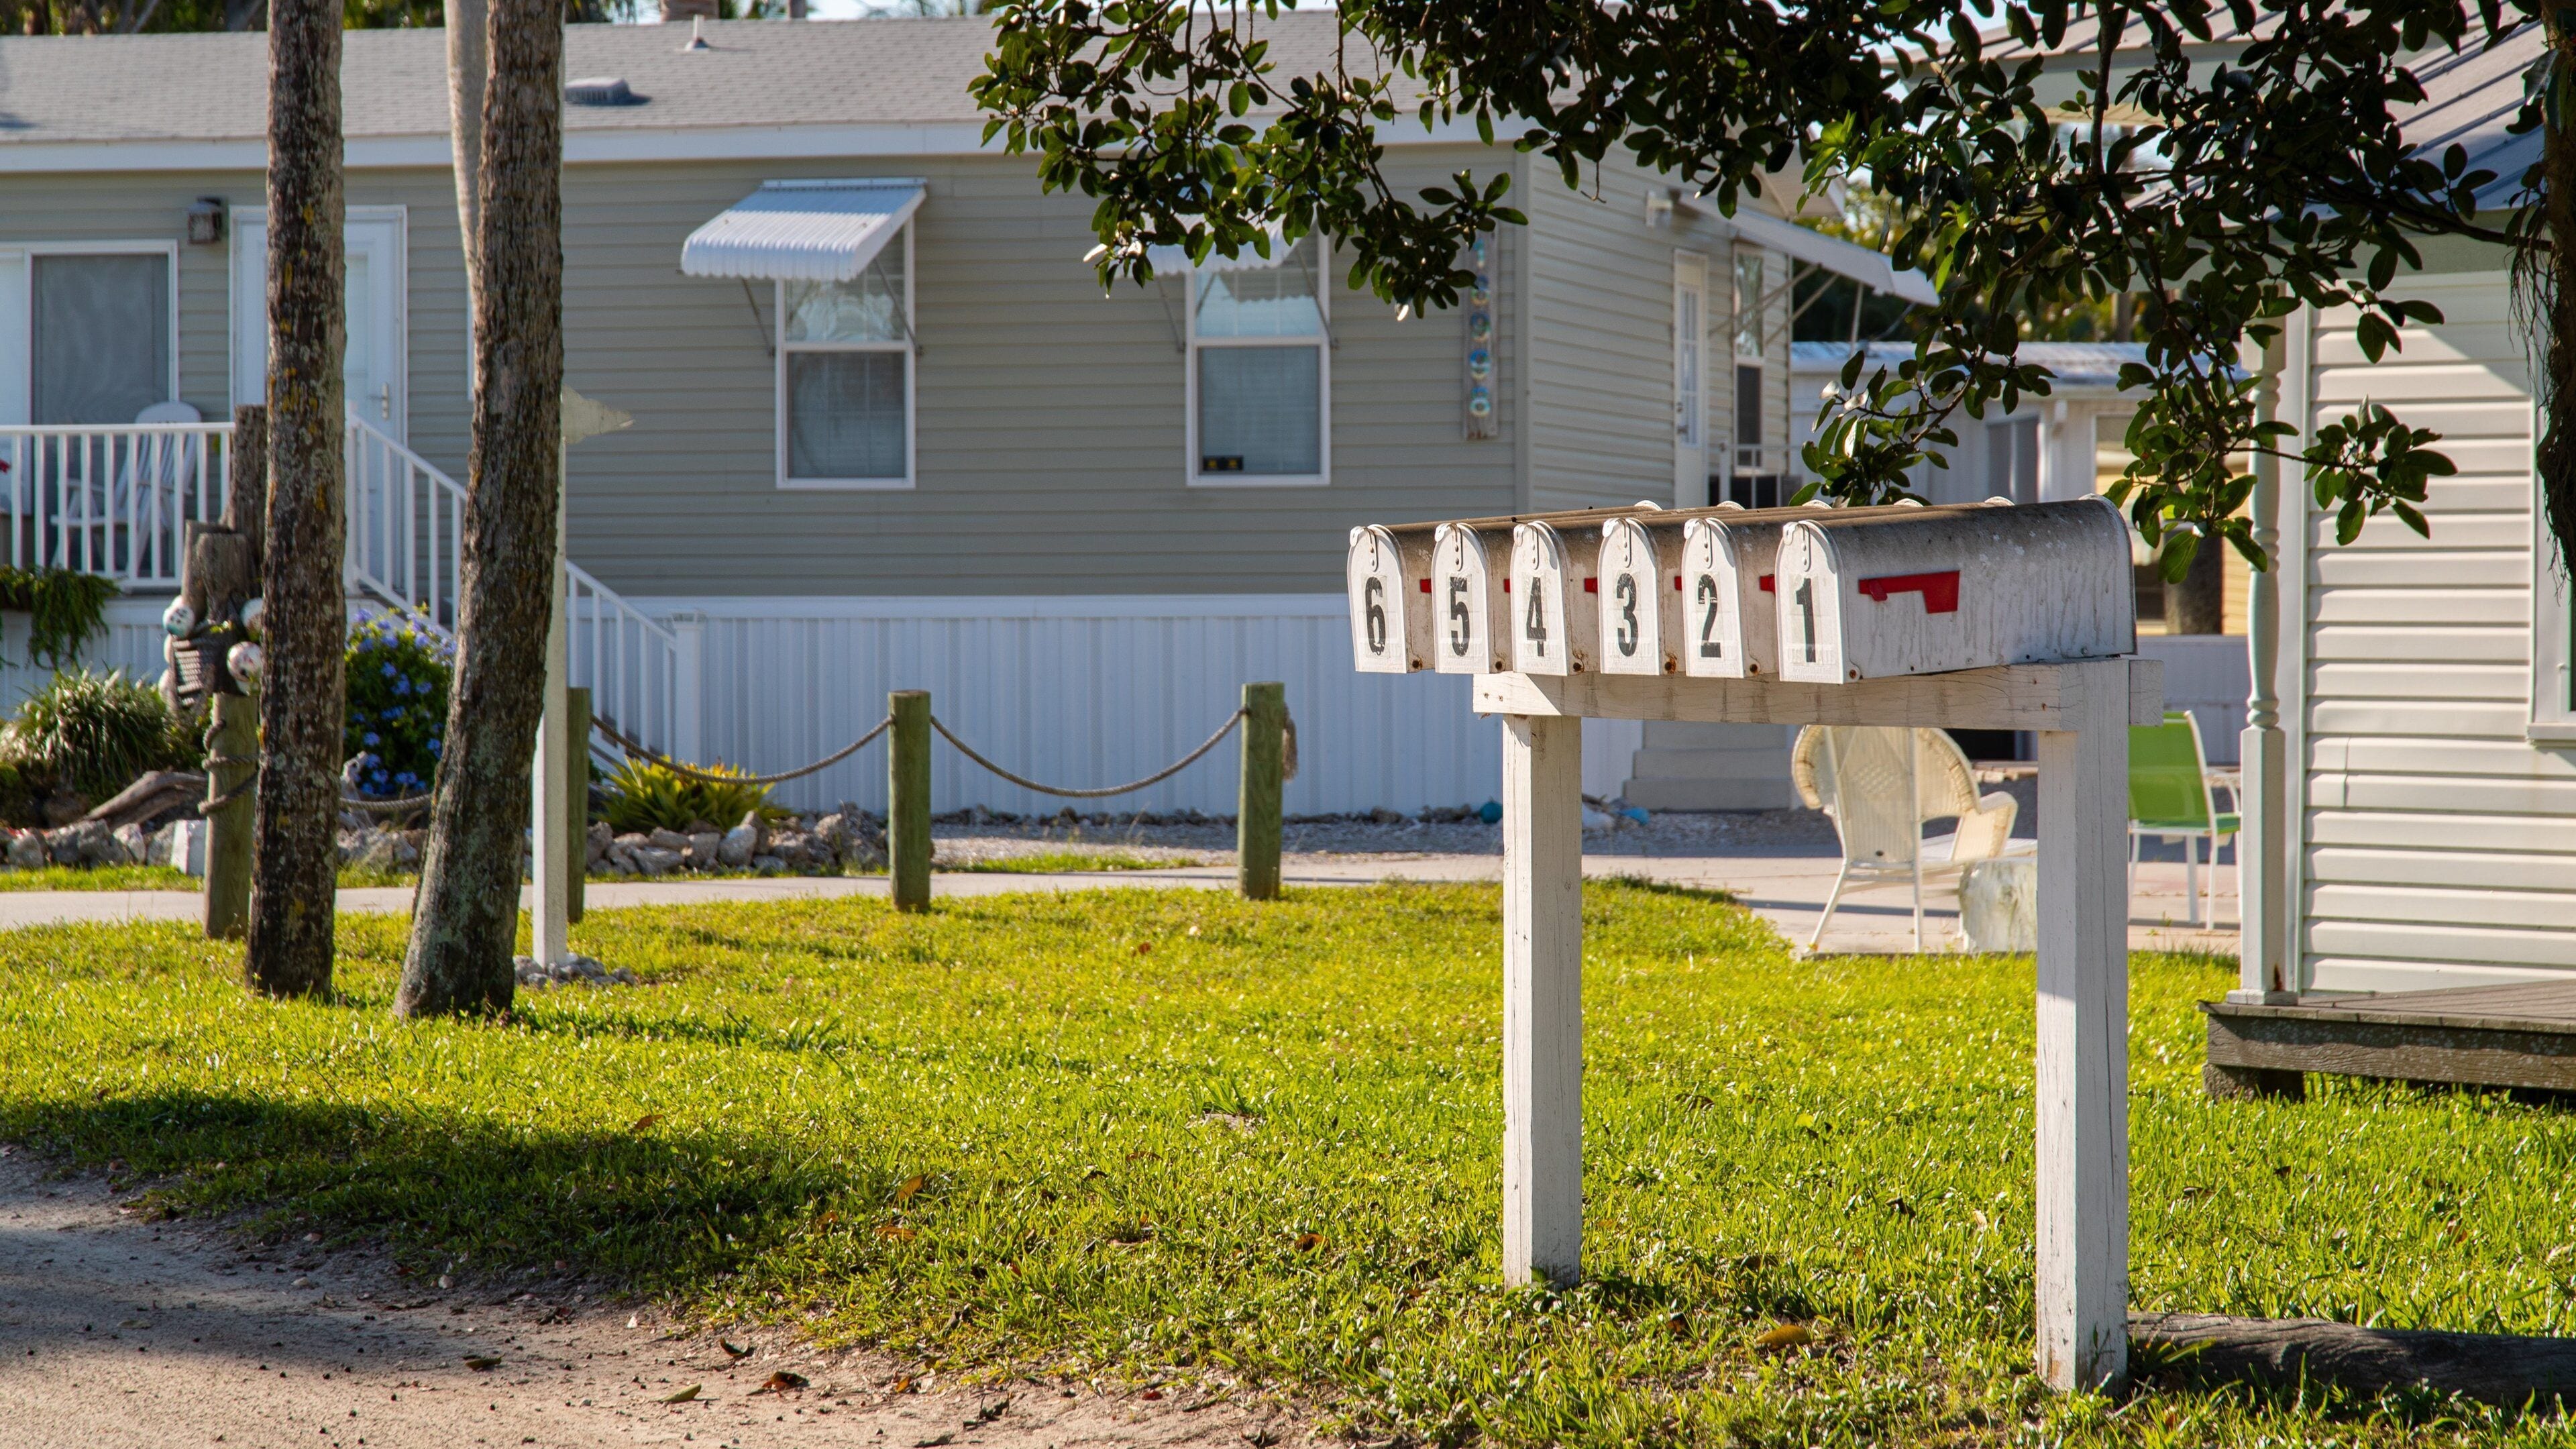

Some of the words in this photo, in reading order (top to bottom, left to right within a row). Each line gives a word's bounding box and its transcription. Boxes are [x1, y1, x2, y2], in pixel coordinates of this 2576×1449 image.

[1366, 578, 1385, 655] 6
[1450, 578, 1470, 656] 5
[1527, 578, 1546, 657] 4
[1617, 574, 1638, 656] 3
[1699, 575, 1721, 657] 2
[1796, 578, 1816, 662] 1
